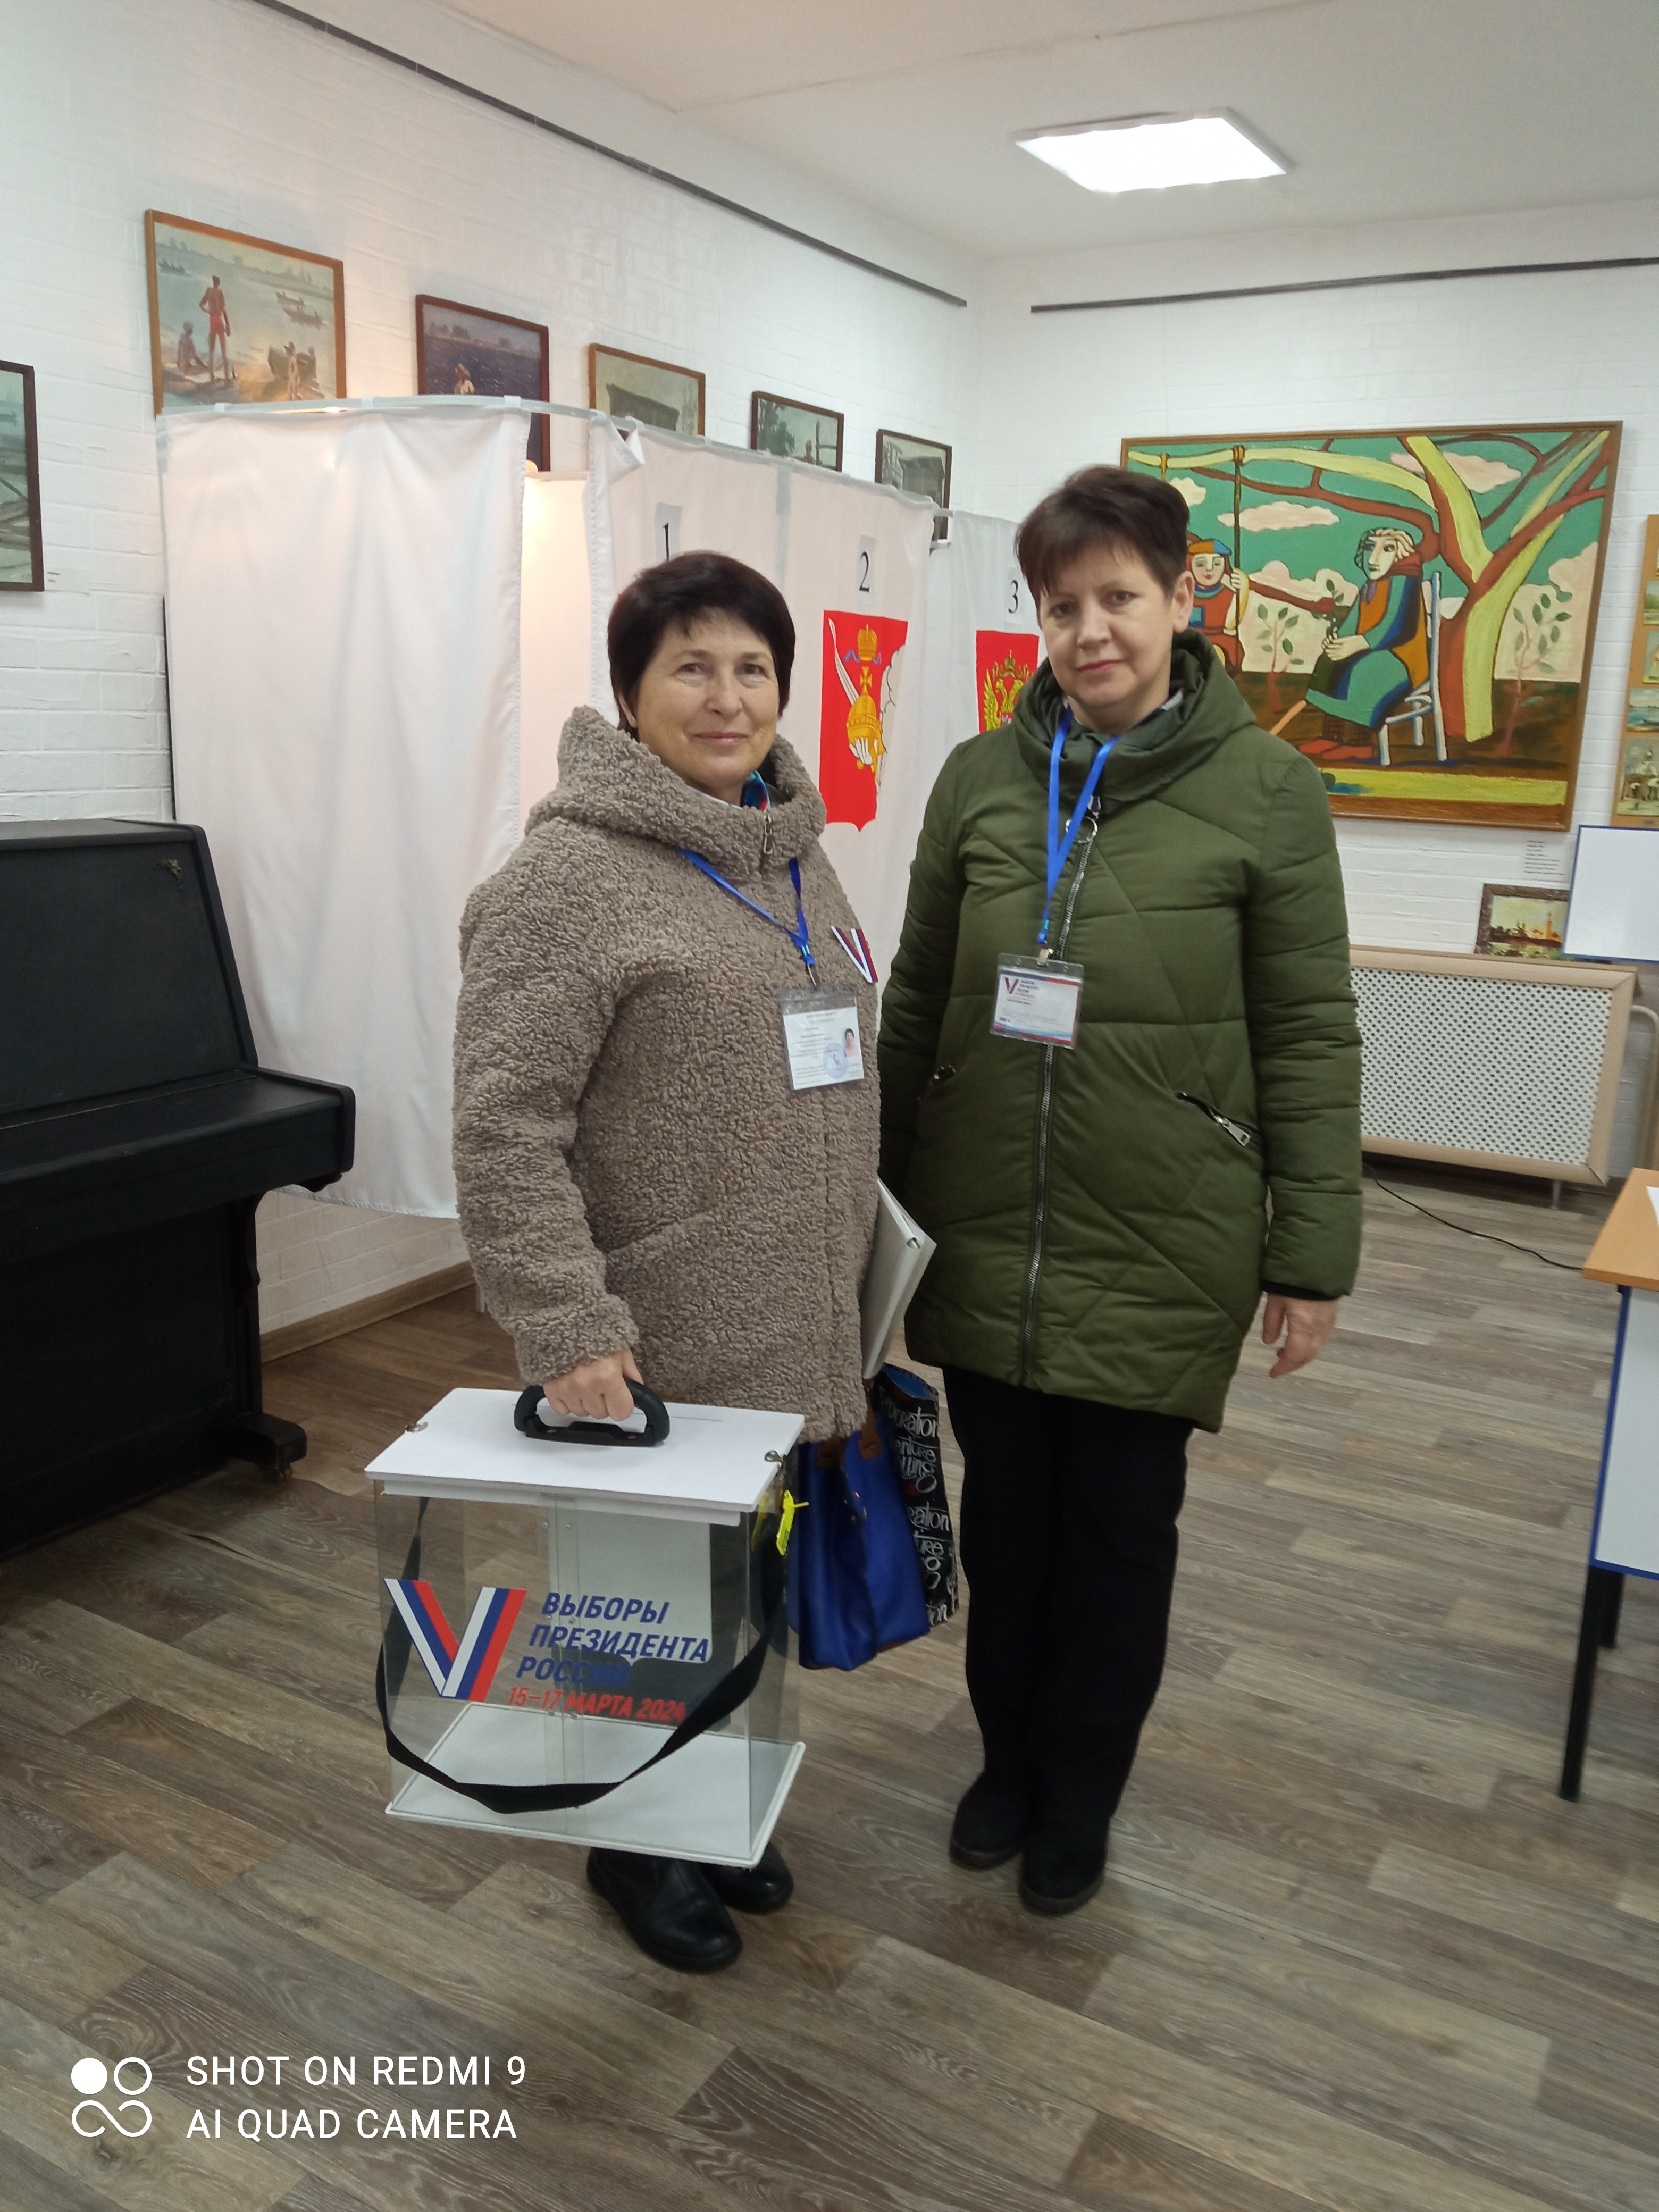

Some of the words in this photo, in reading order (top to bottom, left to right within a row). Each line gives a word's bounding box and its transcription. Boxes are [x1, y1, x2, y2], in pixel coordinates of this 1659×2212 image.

[662, 522, 669, 560] 1
[859, 551, 869, 593] 2
[1008, 579, 1018, 614] 3
[541, 1592, 670, 1624] ВЫБОРЫ
[529, 1624, 709, 1662] ПРЕЗИДЕНТА
[516, 1655, 632, 1687] РОССИИ
[564, 1691, 633, 1717] МАРТА
[635, 1698, 685, 1722] 2024
